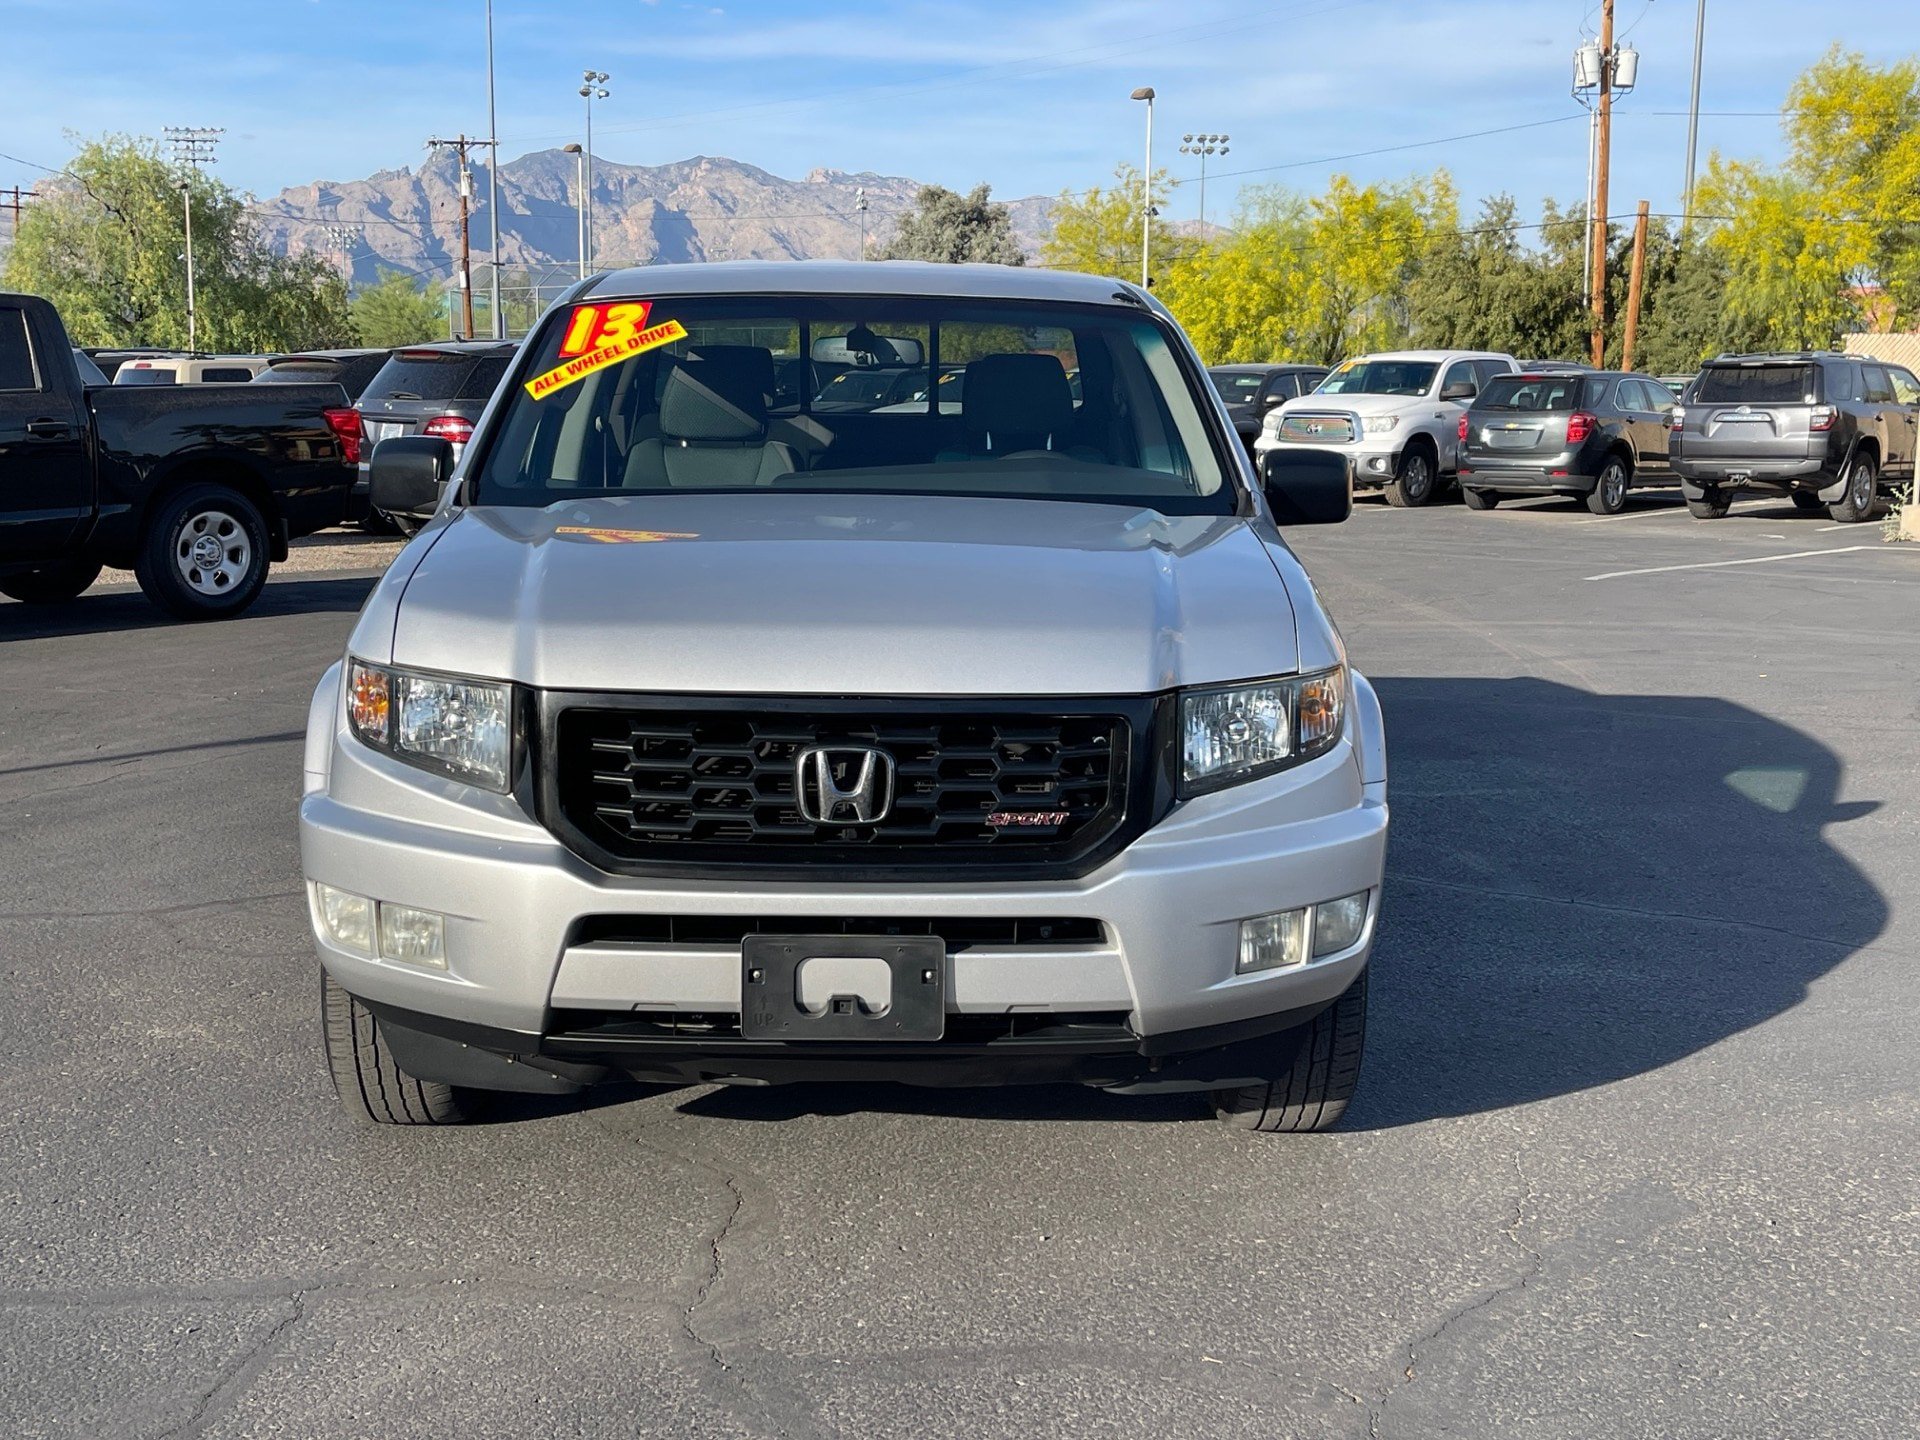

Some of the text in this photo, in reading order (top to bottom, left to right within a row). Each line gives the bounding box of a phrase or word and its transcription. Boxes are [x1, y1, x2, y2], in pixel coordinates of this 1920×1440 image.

[563, 303, 646, 353] 13
[533, 323, 679, 394] ALL WHEEL DRIVE
[985, 812, 1070, 826] SPORT
[753, 1012, 774, 1026] UP
